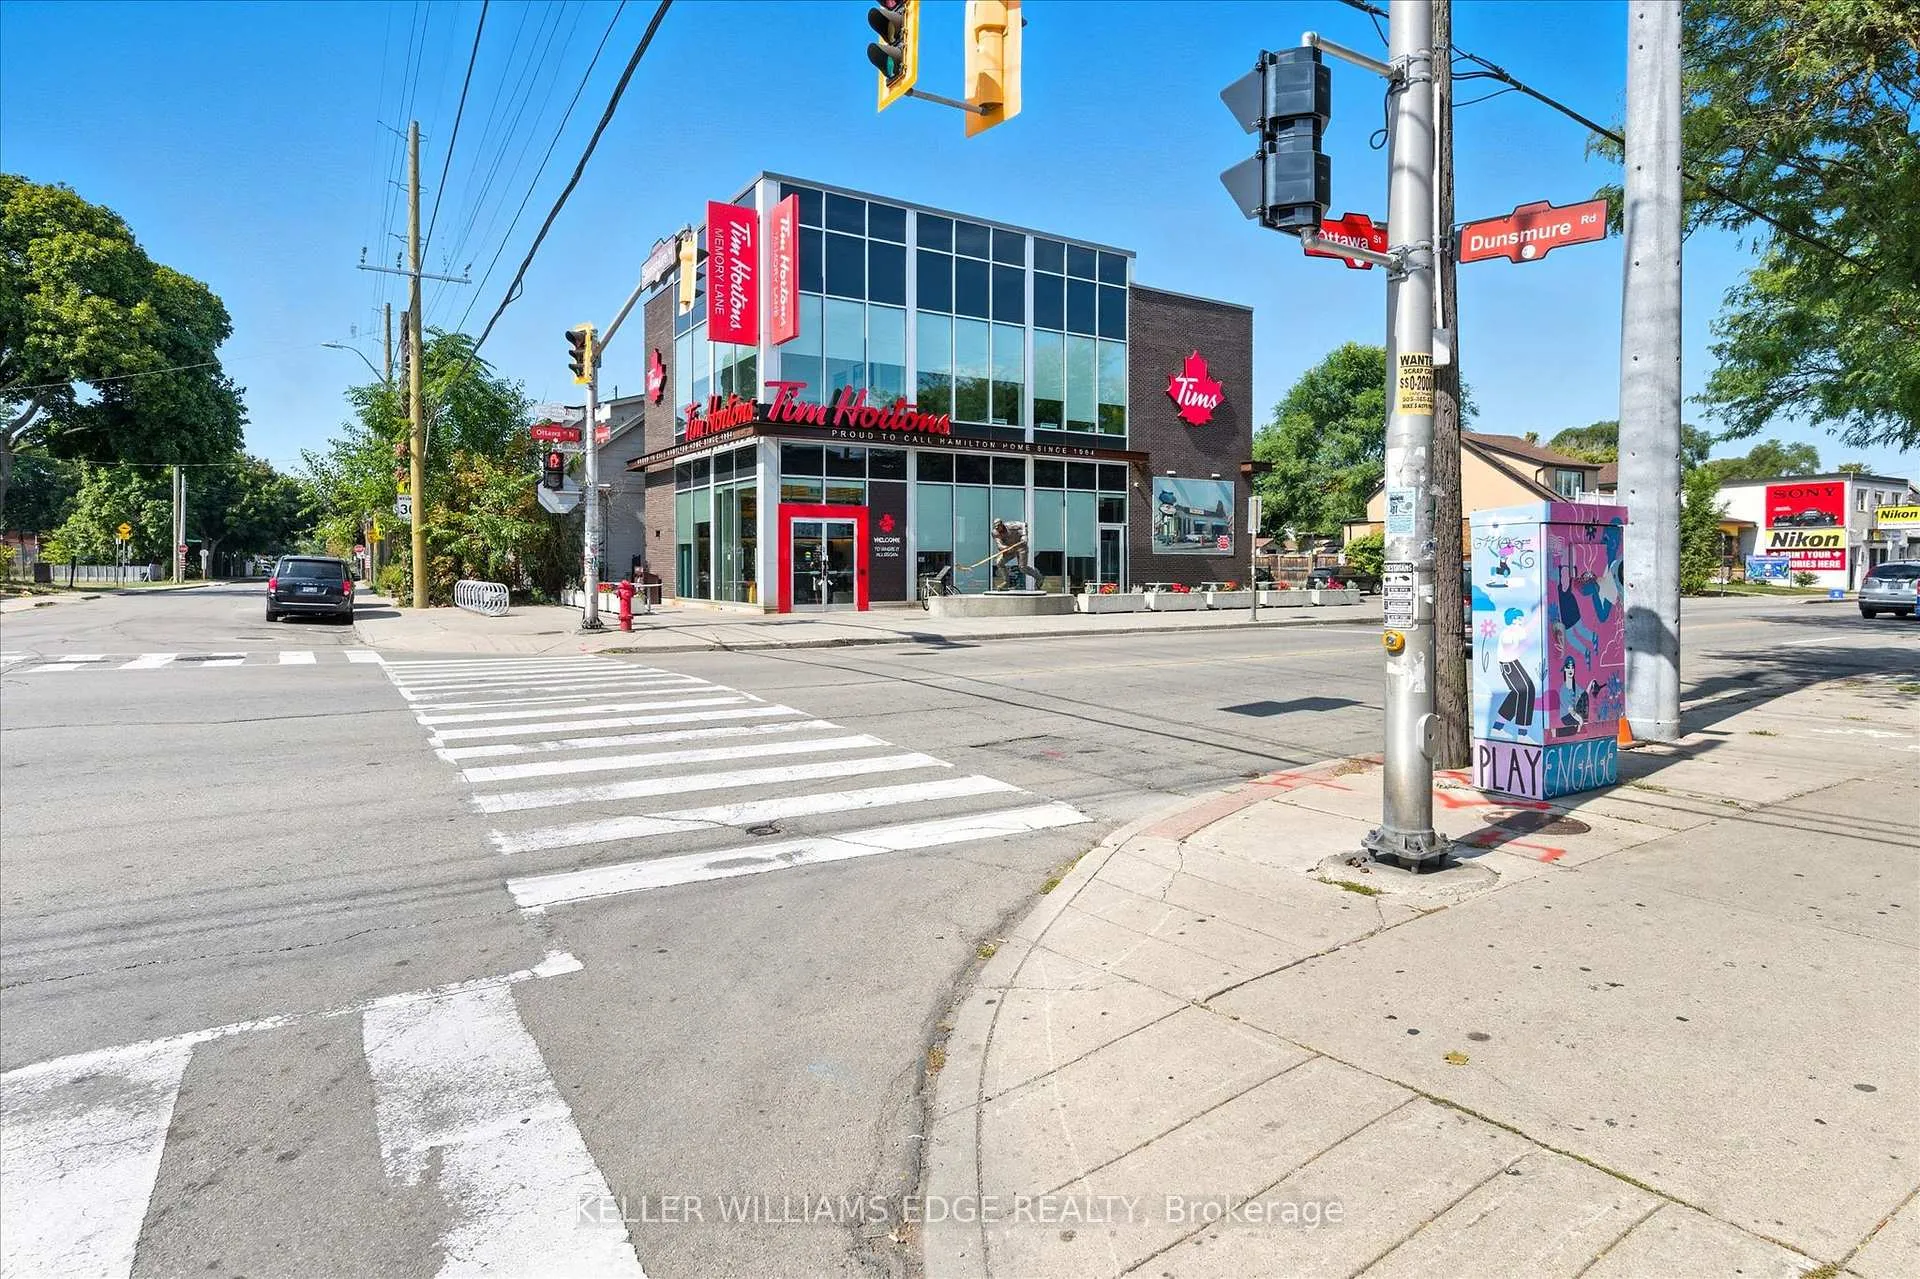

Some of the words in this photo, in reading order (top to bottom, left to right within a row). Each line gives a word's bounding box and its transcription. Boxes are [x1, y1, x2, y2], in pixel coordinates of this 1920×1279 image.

[729, 220, 752, 257] Tim
[1372, 234, 1382, 244] St
[1470, 222, 1572, 252] Dunsmure
[1580, 213, 1597, 225] Rd
[714, 227, 725, 284] MEMORY
[714, 284, 725, 316] LANE
[729, 257, 752, 331] Hortons
[764, 381, 826, 426] Tim
[832, 384, 951, 437] Hortons
[1175, 377, 1217, 410] Tims
[684, 401, 709, 441] Tim
[707, 391, 756, 433] Hortons
[831, 429, 874, 440] PROUD
[882, 433, 896, 441] TO
[903, 434, 932, 444] CALL
[939, 438, 996, 449] HAMILTON
[1002, 442, 1031, 452] HOME
[1038, 445, 1067, 454] SINCE
[1774, 487, 1835, 498] SONY
[400, 504, 411, 515] 3
[1881, 509, 1918, 519] Nikon
[1771, 532, 1840, 547] Nikon
[1807, 551, 1831, 559] YOUR
[1817, 560, 1841, 568] HERE
[1480, 744, 1542, 796] PLAY
[1543, 740, 1617, 797] ENGAGE
